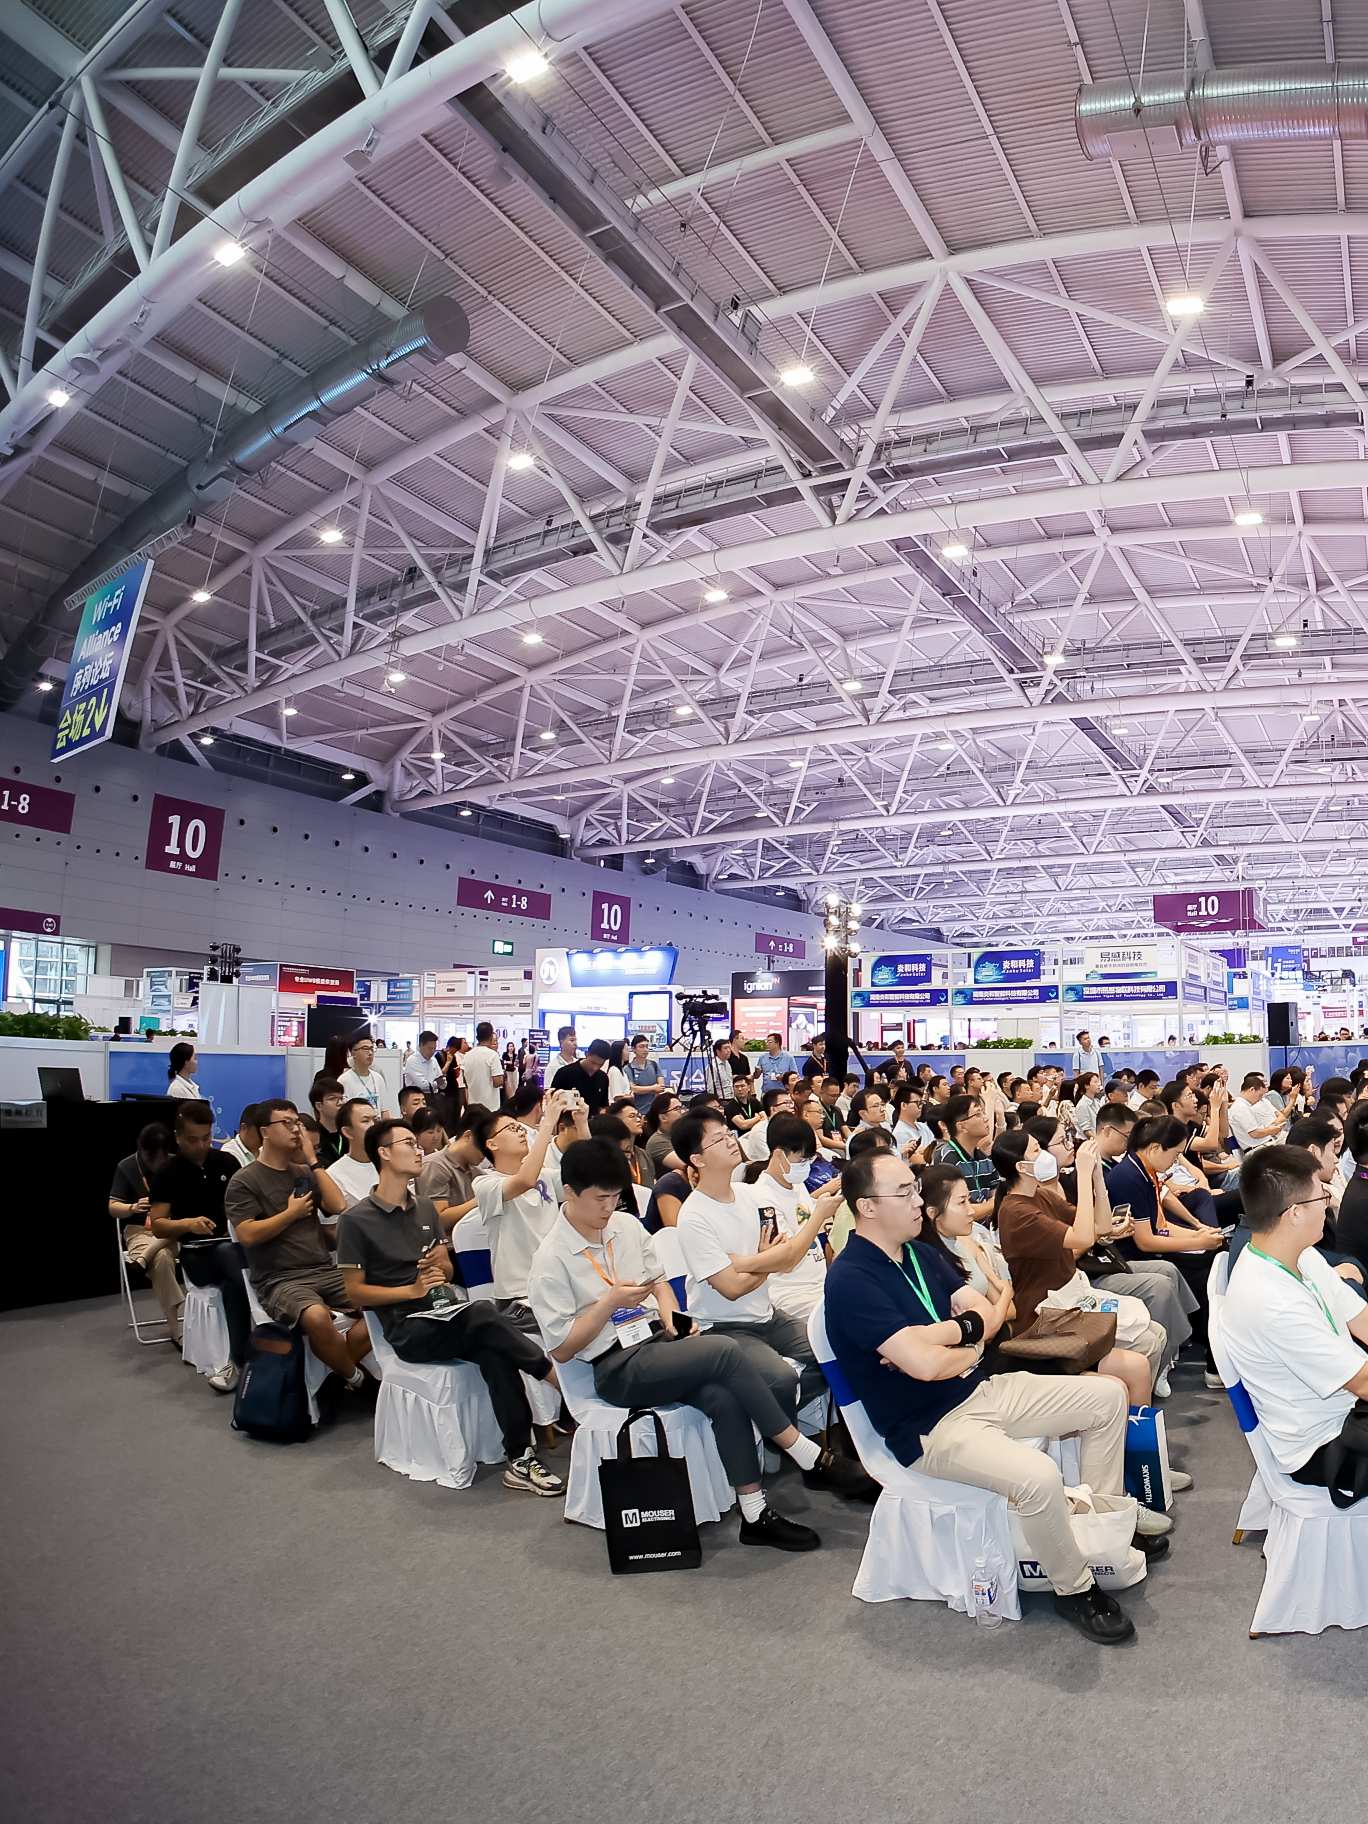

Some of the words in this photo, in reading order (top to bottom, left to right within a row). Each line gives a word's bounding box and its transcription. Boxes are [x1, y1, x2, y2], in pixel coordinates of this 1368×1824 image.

[92, 585, 126, 625] Wi-Fi
[76, 621, 123, 664] Alliance
[55, 696, 97, 751] 会场2
[1, 790, 31, 814] 1-8
[164, 814, 207, 859] 10
[511, 894, 528, 910] 1-8
[1198, 895, 1219, 916] 10
[600, 902, 622, 931] 10
[783, 942, 794, 953] 1-8
[743, 979, 773, 994] ignion
[1141, 1464, 1153, 1503] SKYWORTH
[629, 1551, 682, 1560] www.mouser.com
